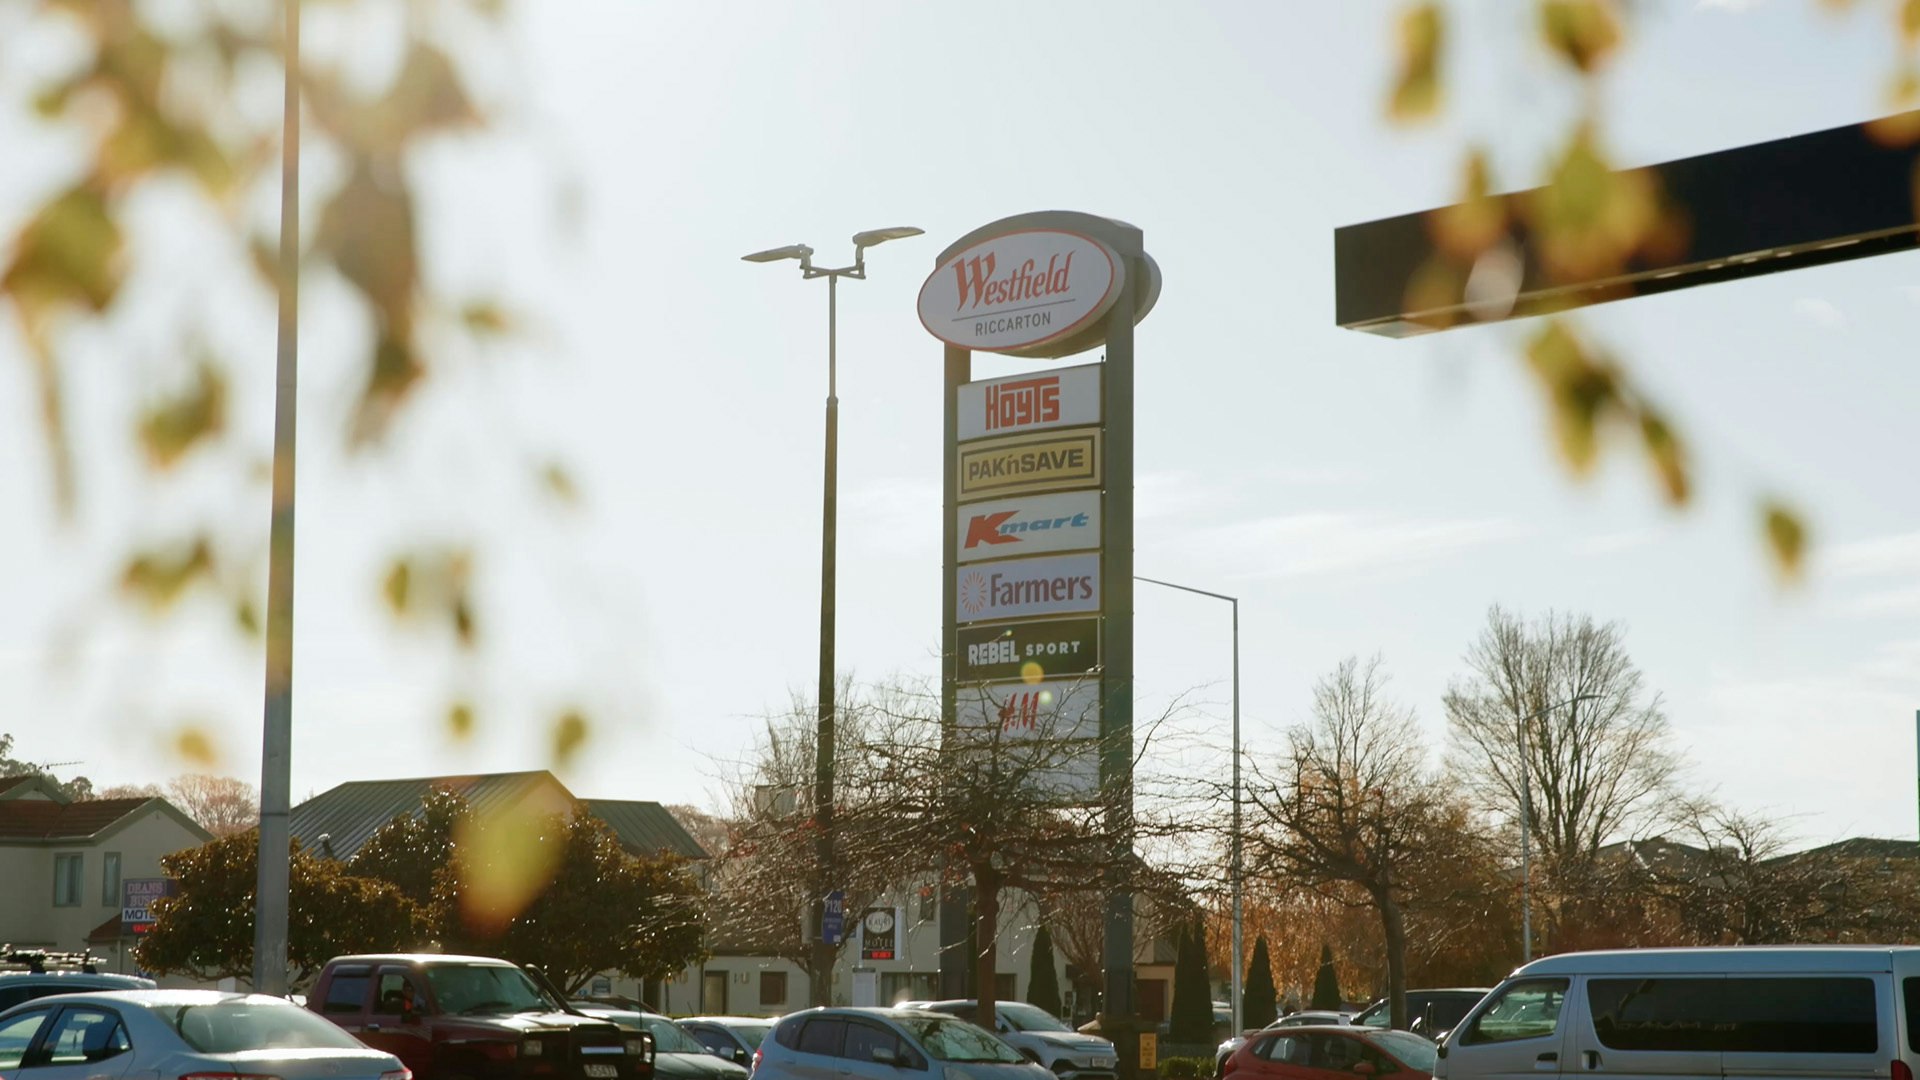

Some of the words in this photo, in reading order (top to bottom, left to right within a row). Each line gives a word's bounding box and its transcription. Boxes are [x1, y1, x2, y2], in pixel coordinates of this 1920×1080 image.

[951, 250, 1076, 312] Westfield
[975, 311, 1051, 336] RICCARTON
[985, 376, 1060, 431] HOYTS
[964, 510, 1089, 549] Kmart
[990, 573, 1093, 607] Farmers
[968, 640, 1020, 666] REBEL
[1025, 640, 1081, 657] SPORT
[124, 910, 156, 920] MOT
